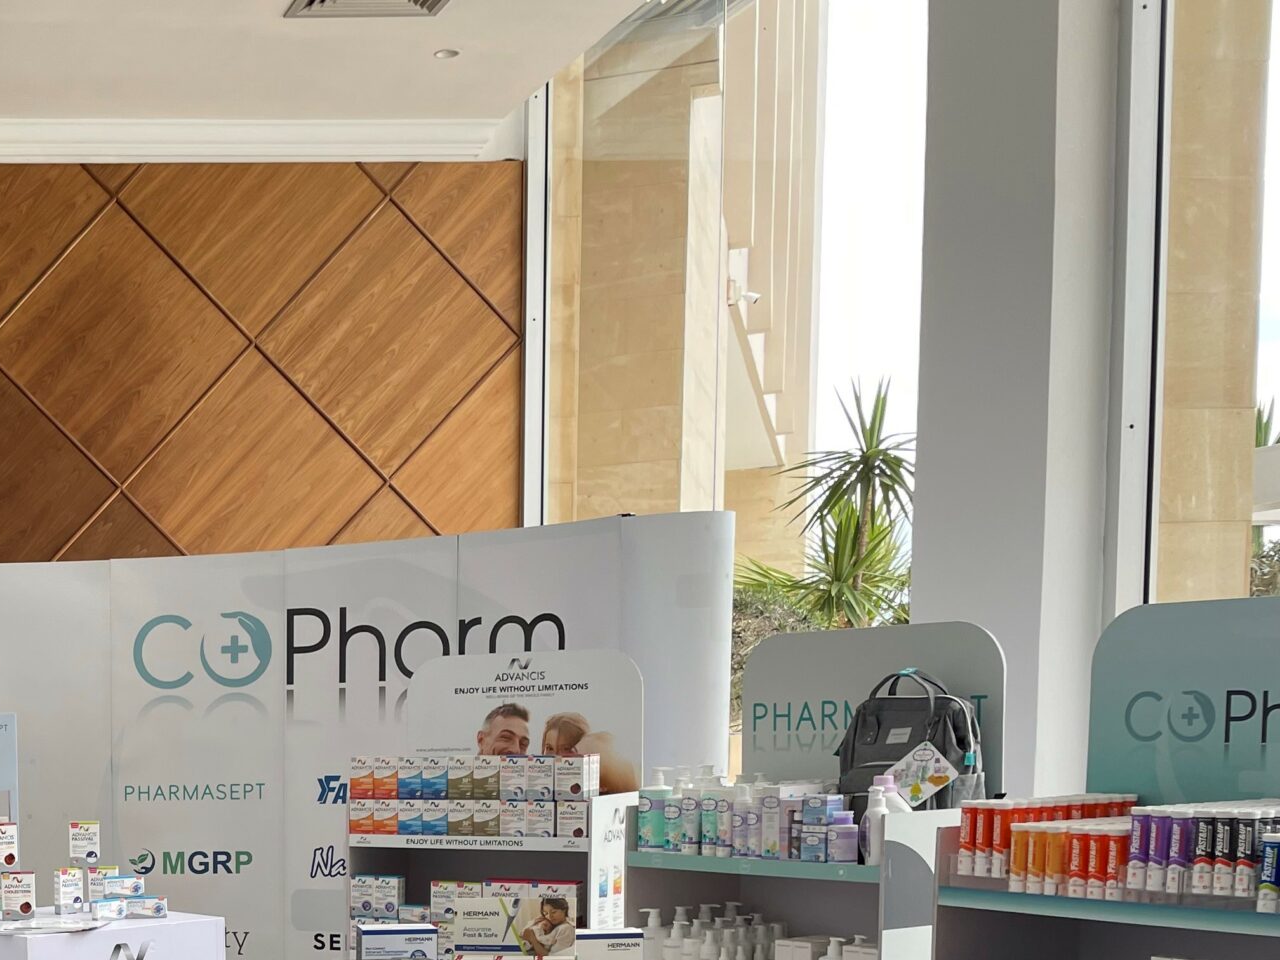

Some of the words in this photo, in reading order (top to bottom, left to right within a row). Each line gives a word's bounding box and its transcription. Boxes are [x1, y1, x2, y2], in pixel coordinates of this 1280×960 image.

[495, 671, 546, 682] ADVANCIS
[499, 685, 536, 693] WITHOUT
[537, 683, 589, 692] LIMITATIONS
[124, 783, 266, 801] PHARMASEPT
[163, 851, 253, 874] MGRP
